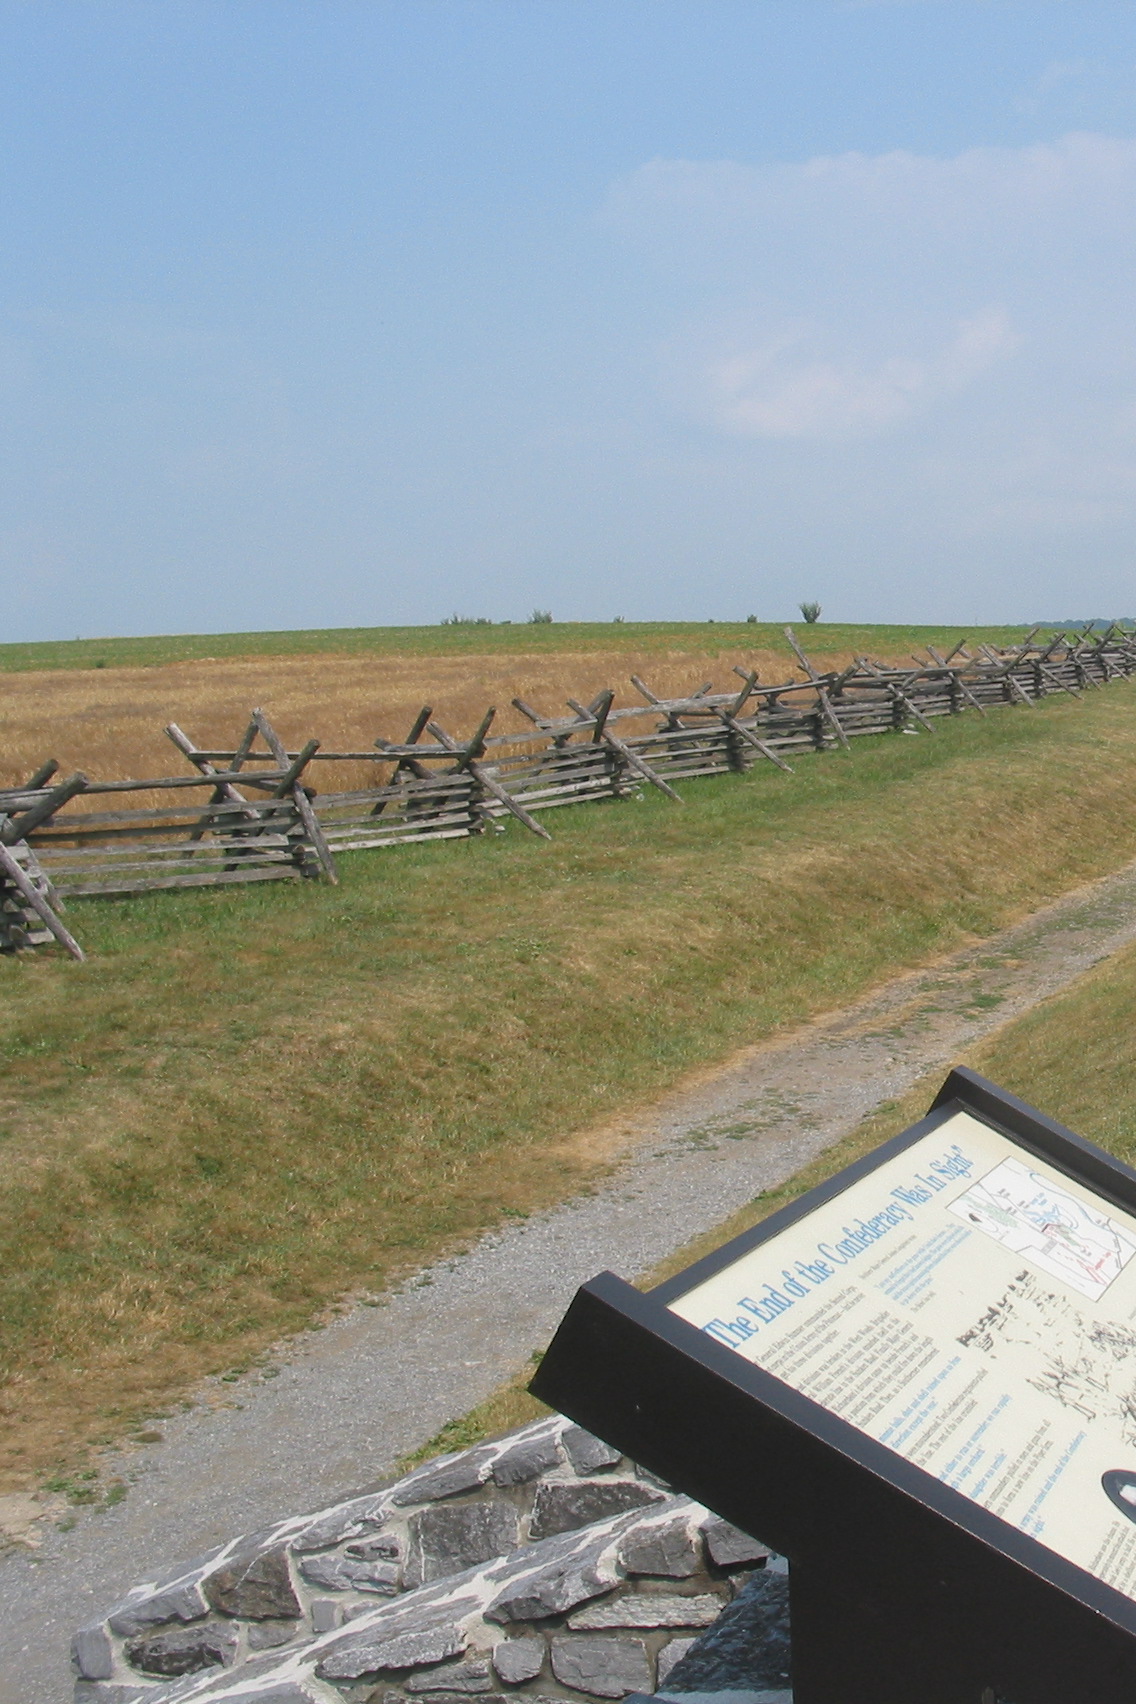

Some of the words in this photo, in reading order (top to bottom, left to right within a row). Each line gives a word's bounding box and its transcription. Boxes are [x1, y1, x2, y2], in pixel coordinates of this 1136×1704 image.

[888, 1178, 935, 1210] Was
[911, 1168, 947, 1192] In
[811, 1194, 919, 1271] Confederacy
[768, 1268, 814, 1299] of
[787, 1251, 837, 1285] the
[733, 1282, 795, 1324] End
[698, 1307, 762, 1350] The
